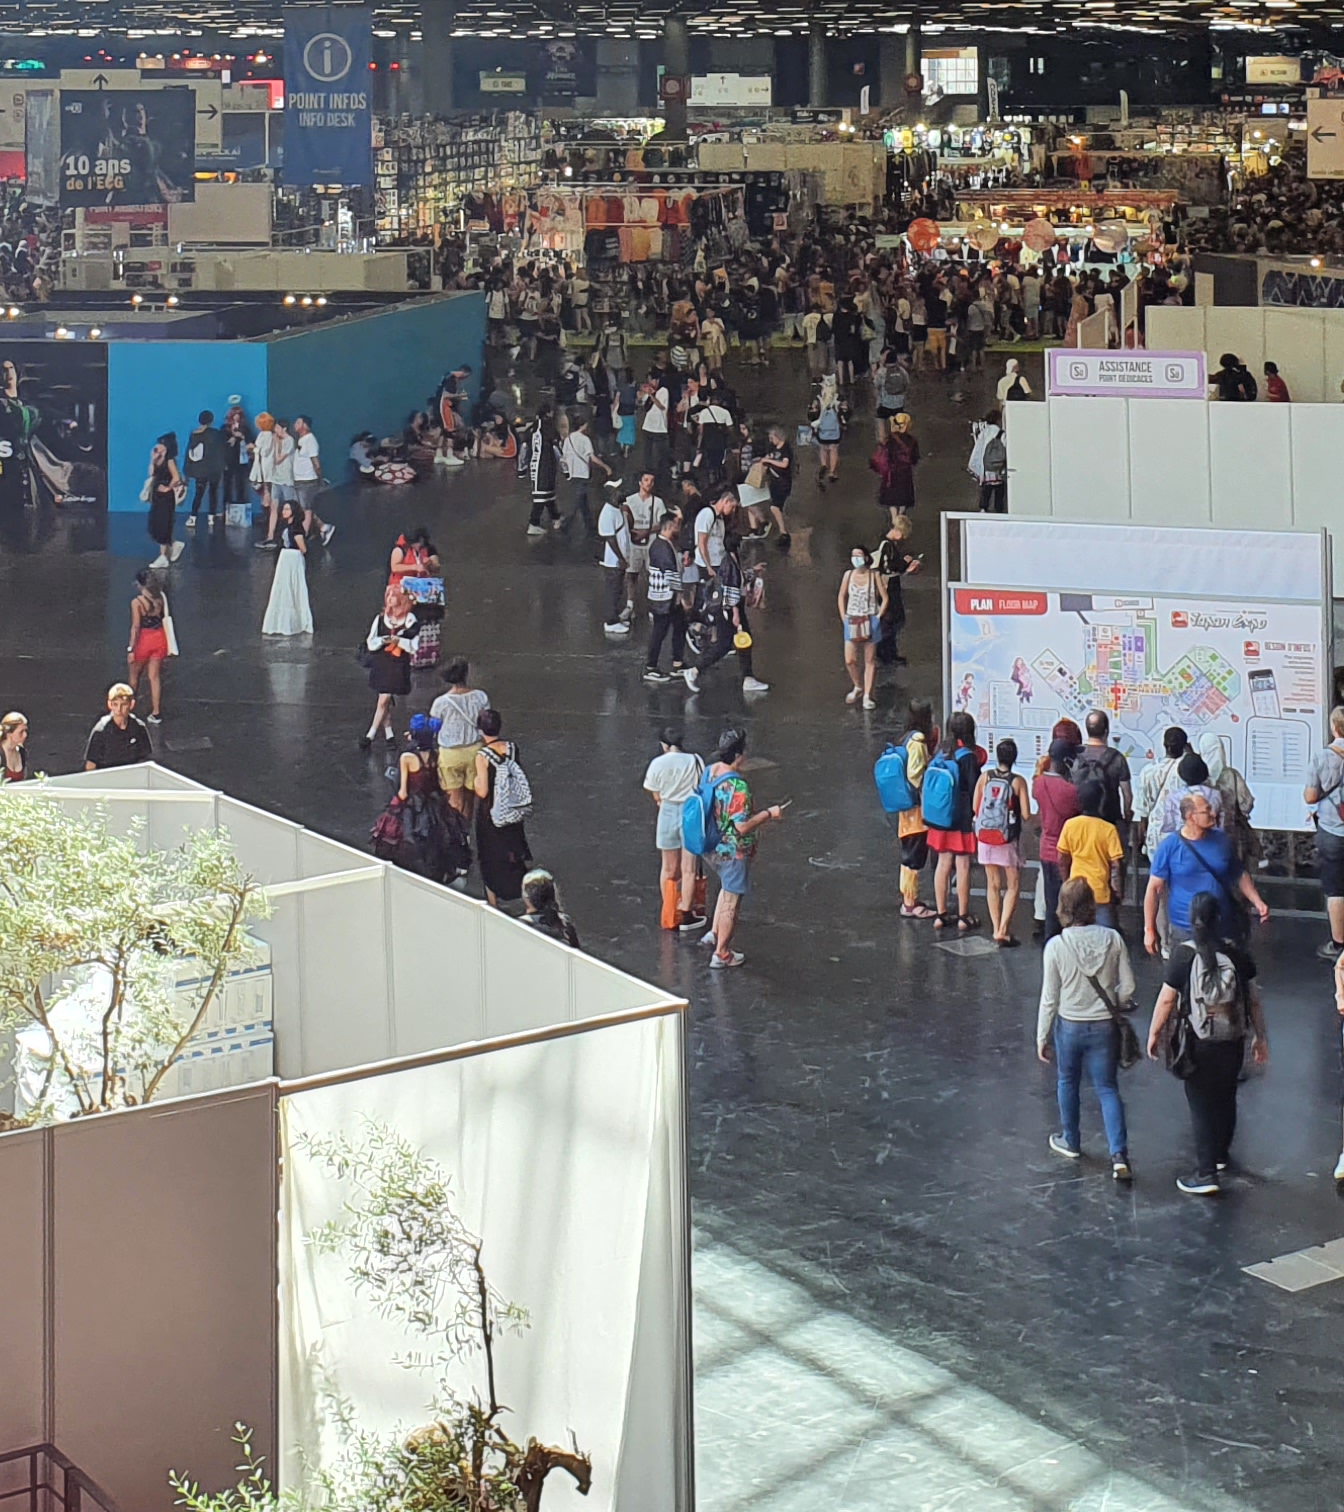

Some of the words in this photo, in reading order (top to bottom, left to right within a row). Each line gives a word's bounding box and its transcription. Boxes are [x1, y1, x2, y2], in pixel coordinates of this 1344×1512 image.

[288, 93, 325, 109] POINT
[329, 92, 367, 109] INFOS
[299, 112, 325, 126] INFO
[327, 113, 355, 126] DESK
[65, 155, 90, 175] 10
[94, 158, 131, 175] ans
[66, 177, 83, 190] de
[1098, 361, 1152, 373] ASSISTANCE
[1098, 374, 1117, 383] POINT
[970, 599, 993, 611] PLAN
[998, 599, 1021, 610] FLOOR
[1022, 599, 1039, 610] MAP
